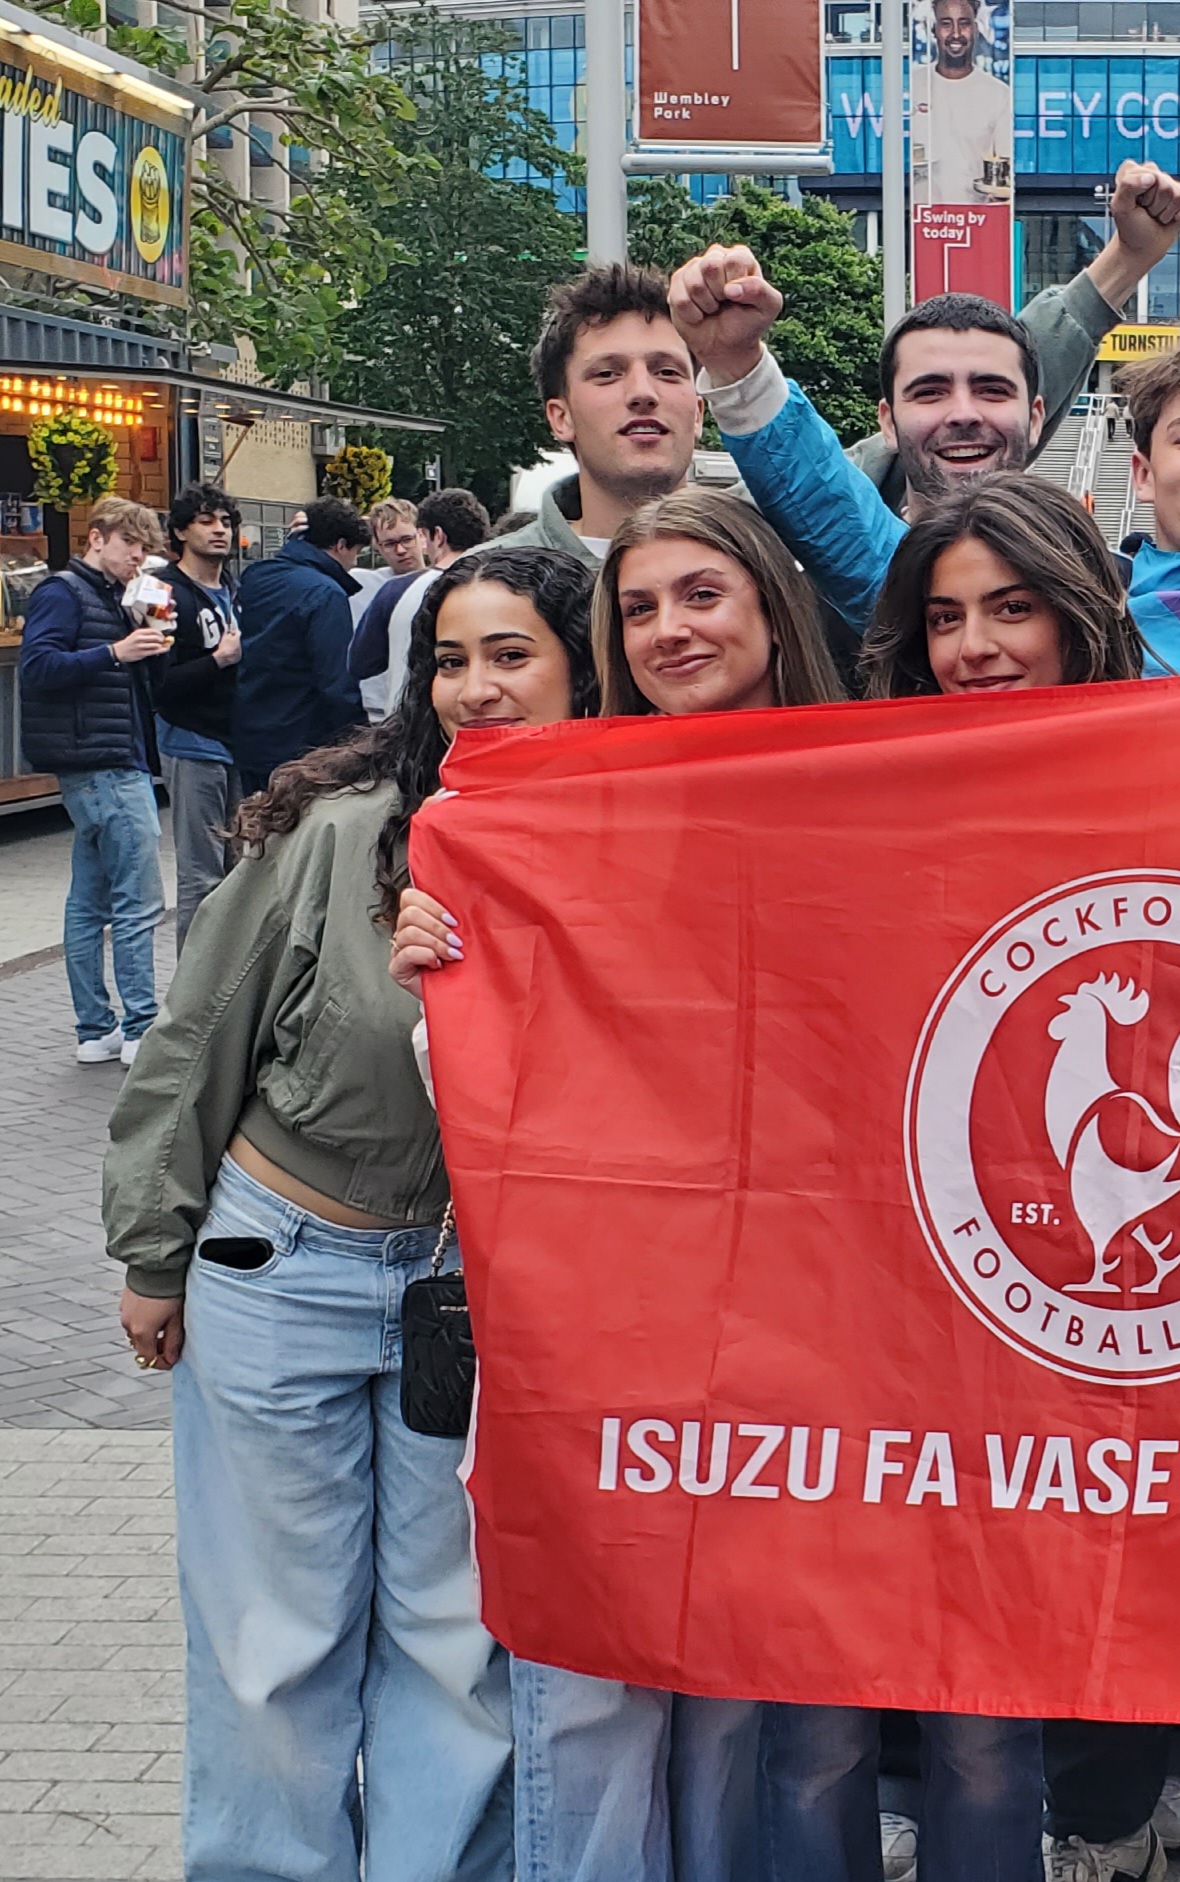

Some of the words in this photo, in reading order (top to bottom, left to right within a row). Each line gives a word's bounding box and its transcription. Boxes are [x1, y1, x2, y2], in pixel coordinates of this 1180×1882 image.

[653, 91, 731, 108] Wembley
[653, 107, 692, 120] Park
[922, 210, 965, 226] Swing
[968, 210, 986, 226] by
[922, 226, 964, 241] today
[1010, 1202, 1061, 1226] EST.
[598, 1417, 841, 1501] ISUZU
[862, 1430, 958, 1507] FA
[984, 1433, 1179, 1515] VASE
